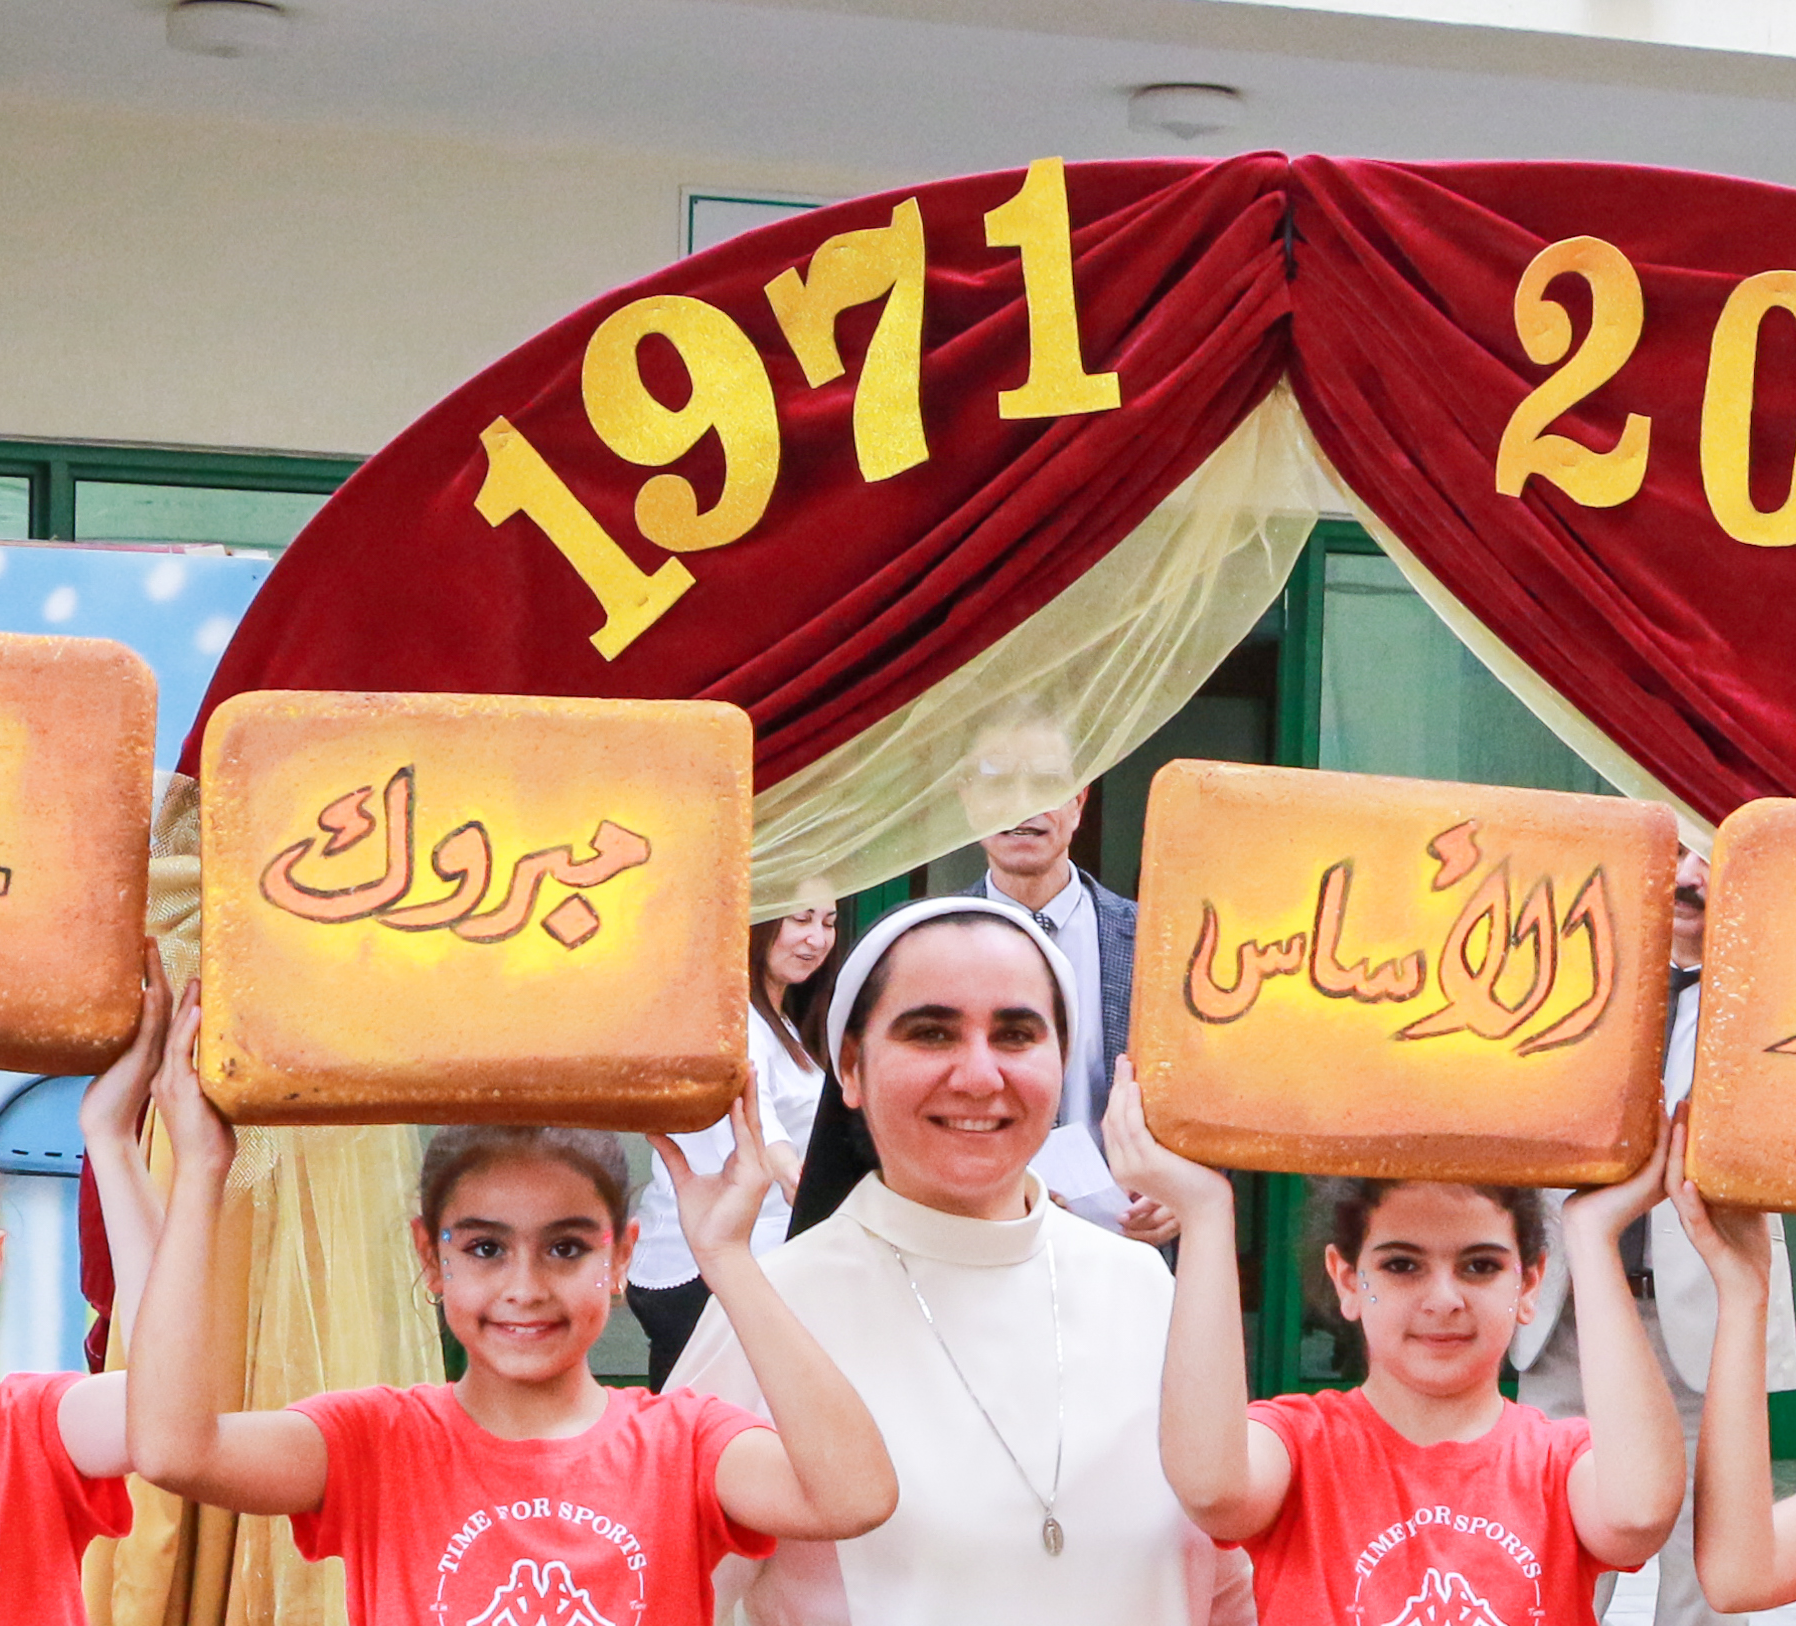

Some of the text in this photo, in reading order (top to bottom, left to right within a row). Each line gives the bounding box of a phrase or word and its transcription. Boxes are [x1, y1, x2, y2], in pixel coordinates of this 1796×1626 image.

[474, 156, 1121, 661] 1971
[260, 763, 651, 951] مبروك
[1183, 817, 1618, 1058] الأساس
[438, 1497, 647, 1574] TIME FOR SPORTS
[1355, 1522, 1406, 1578] TIME
[1453, 1514, 1542, 1579] SPORTS
